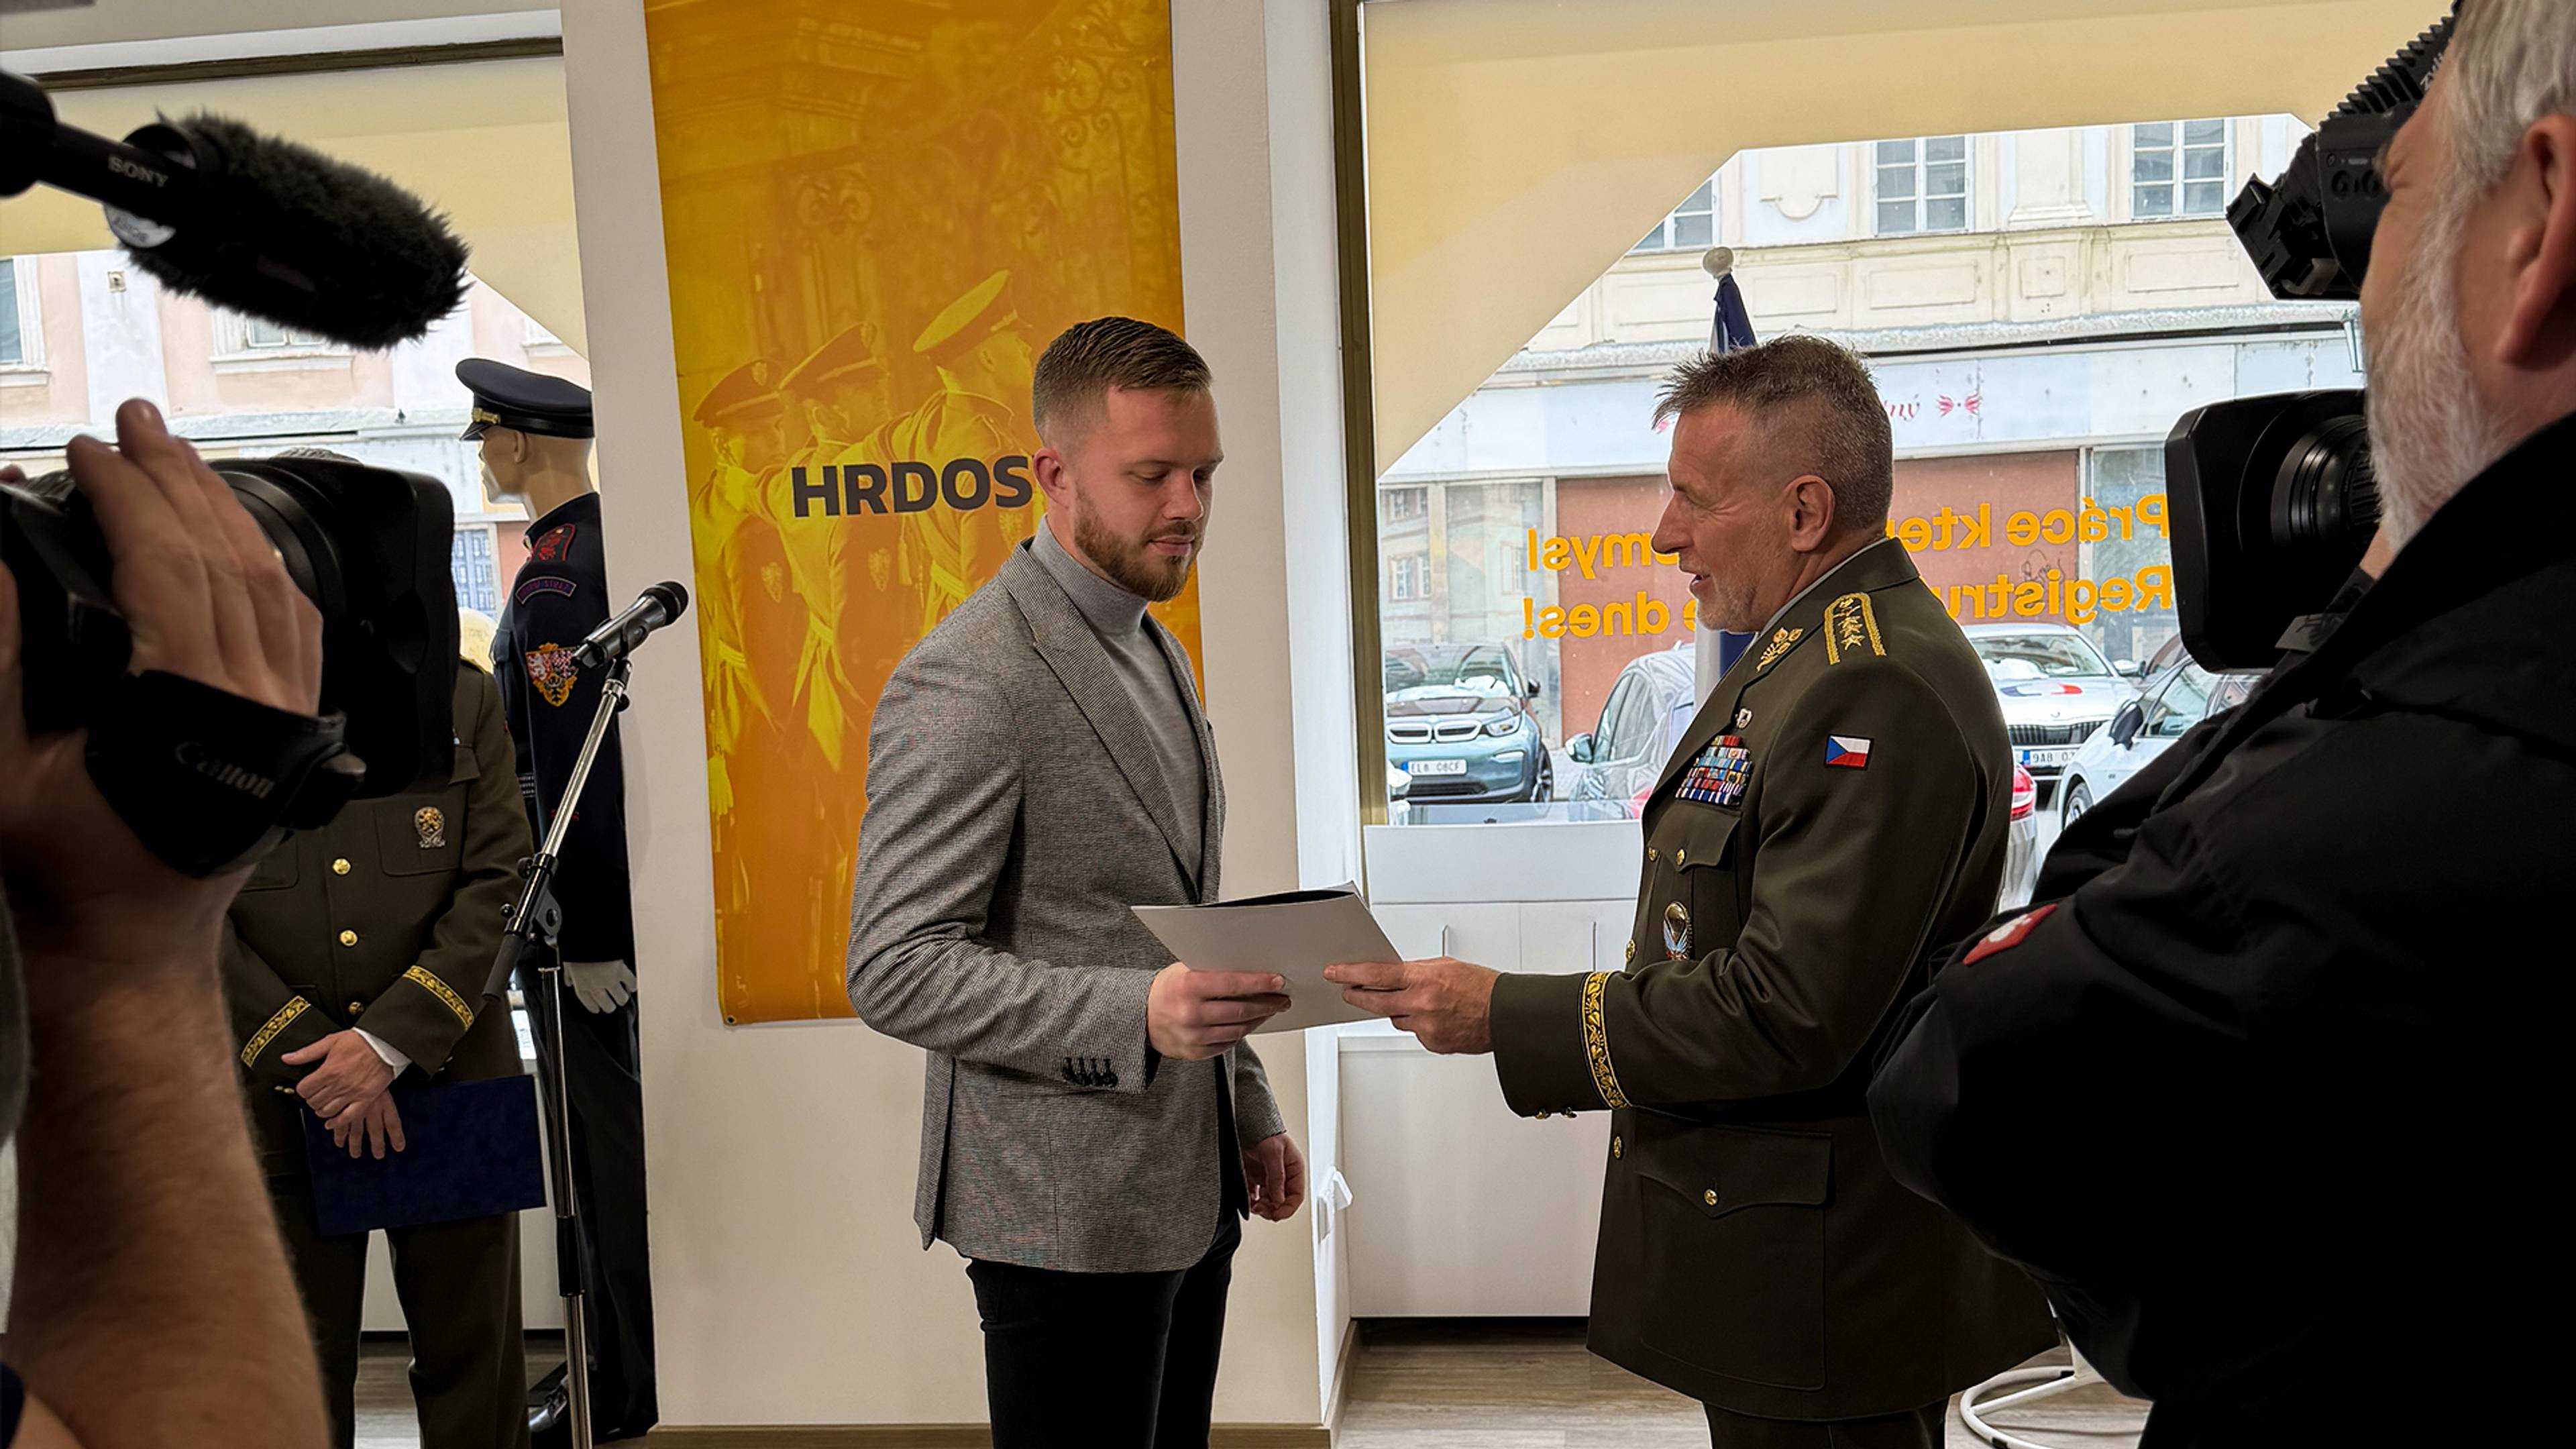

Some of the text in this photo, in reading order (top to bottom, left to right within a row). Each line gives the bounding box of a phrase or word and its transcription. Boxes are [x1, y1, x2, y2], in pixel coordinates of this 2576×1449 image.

[107, 156, 169, 187] SONY
[792, 454, 1034, 518] HRDOS
[175, 741, 276, 799] Canon
